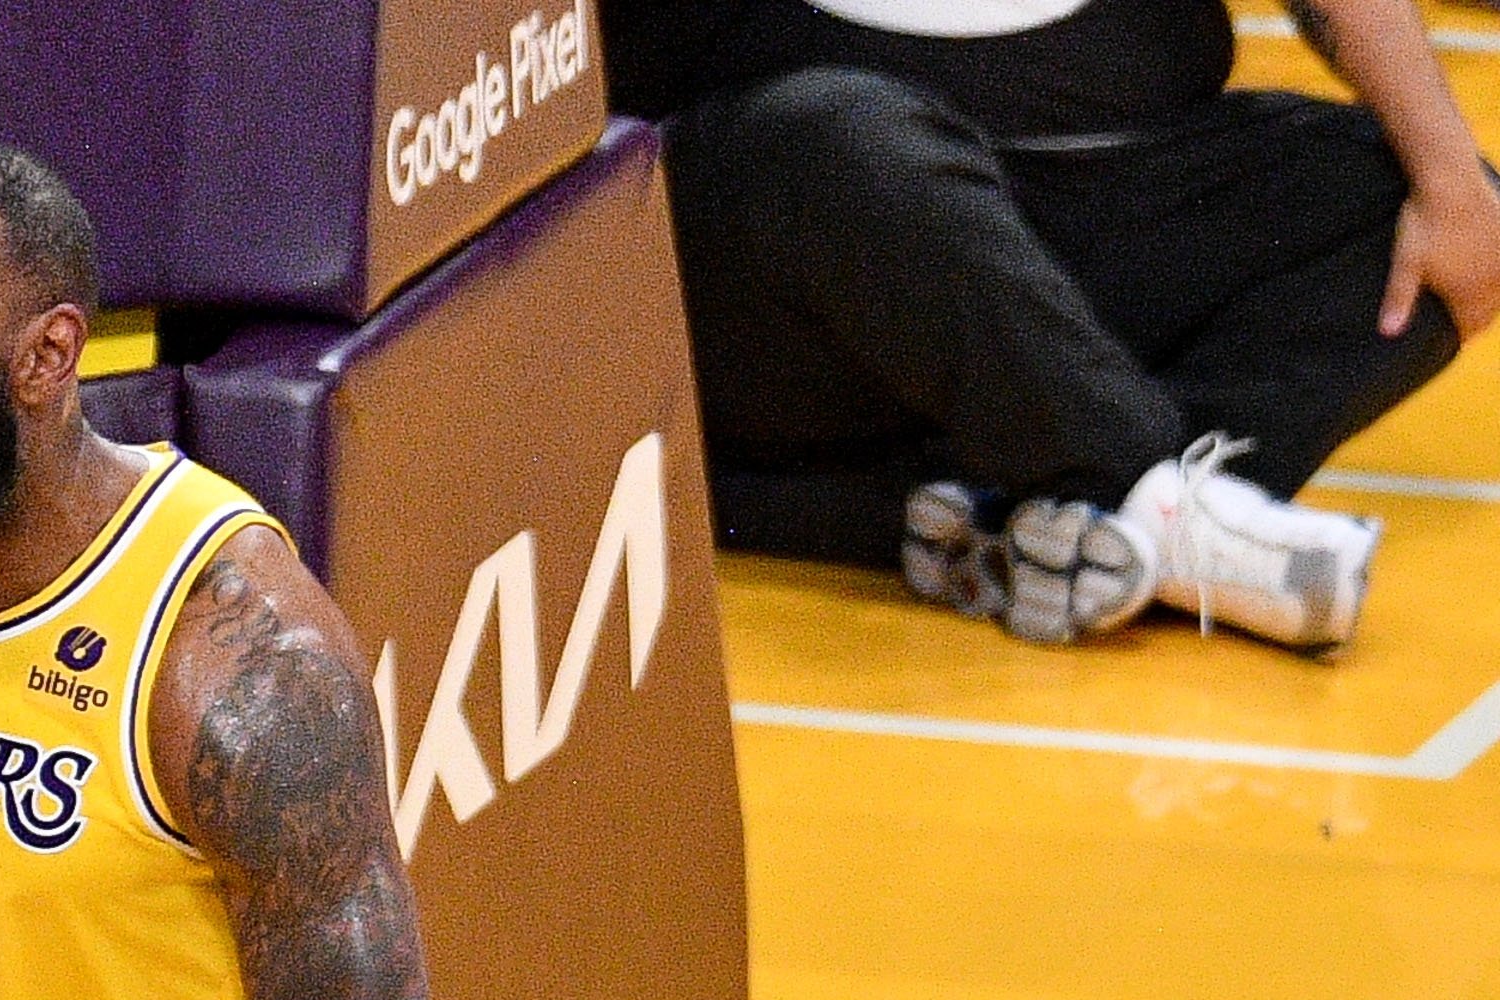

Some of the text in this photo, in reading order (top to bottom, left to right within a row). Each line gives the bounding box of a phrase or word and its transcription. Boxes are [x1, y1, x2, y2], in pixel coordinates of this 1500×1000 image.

[386, 0, 589, 206] Google Pixel
[27, 664, 109, 712] bibigo
